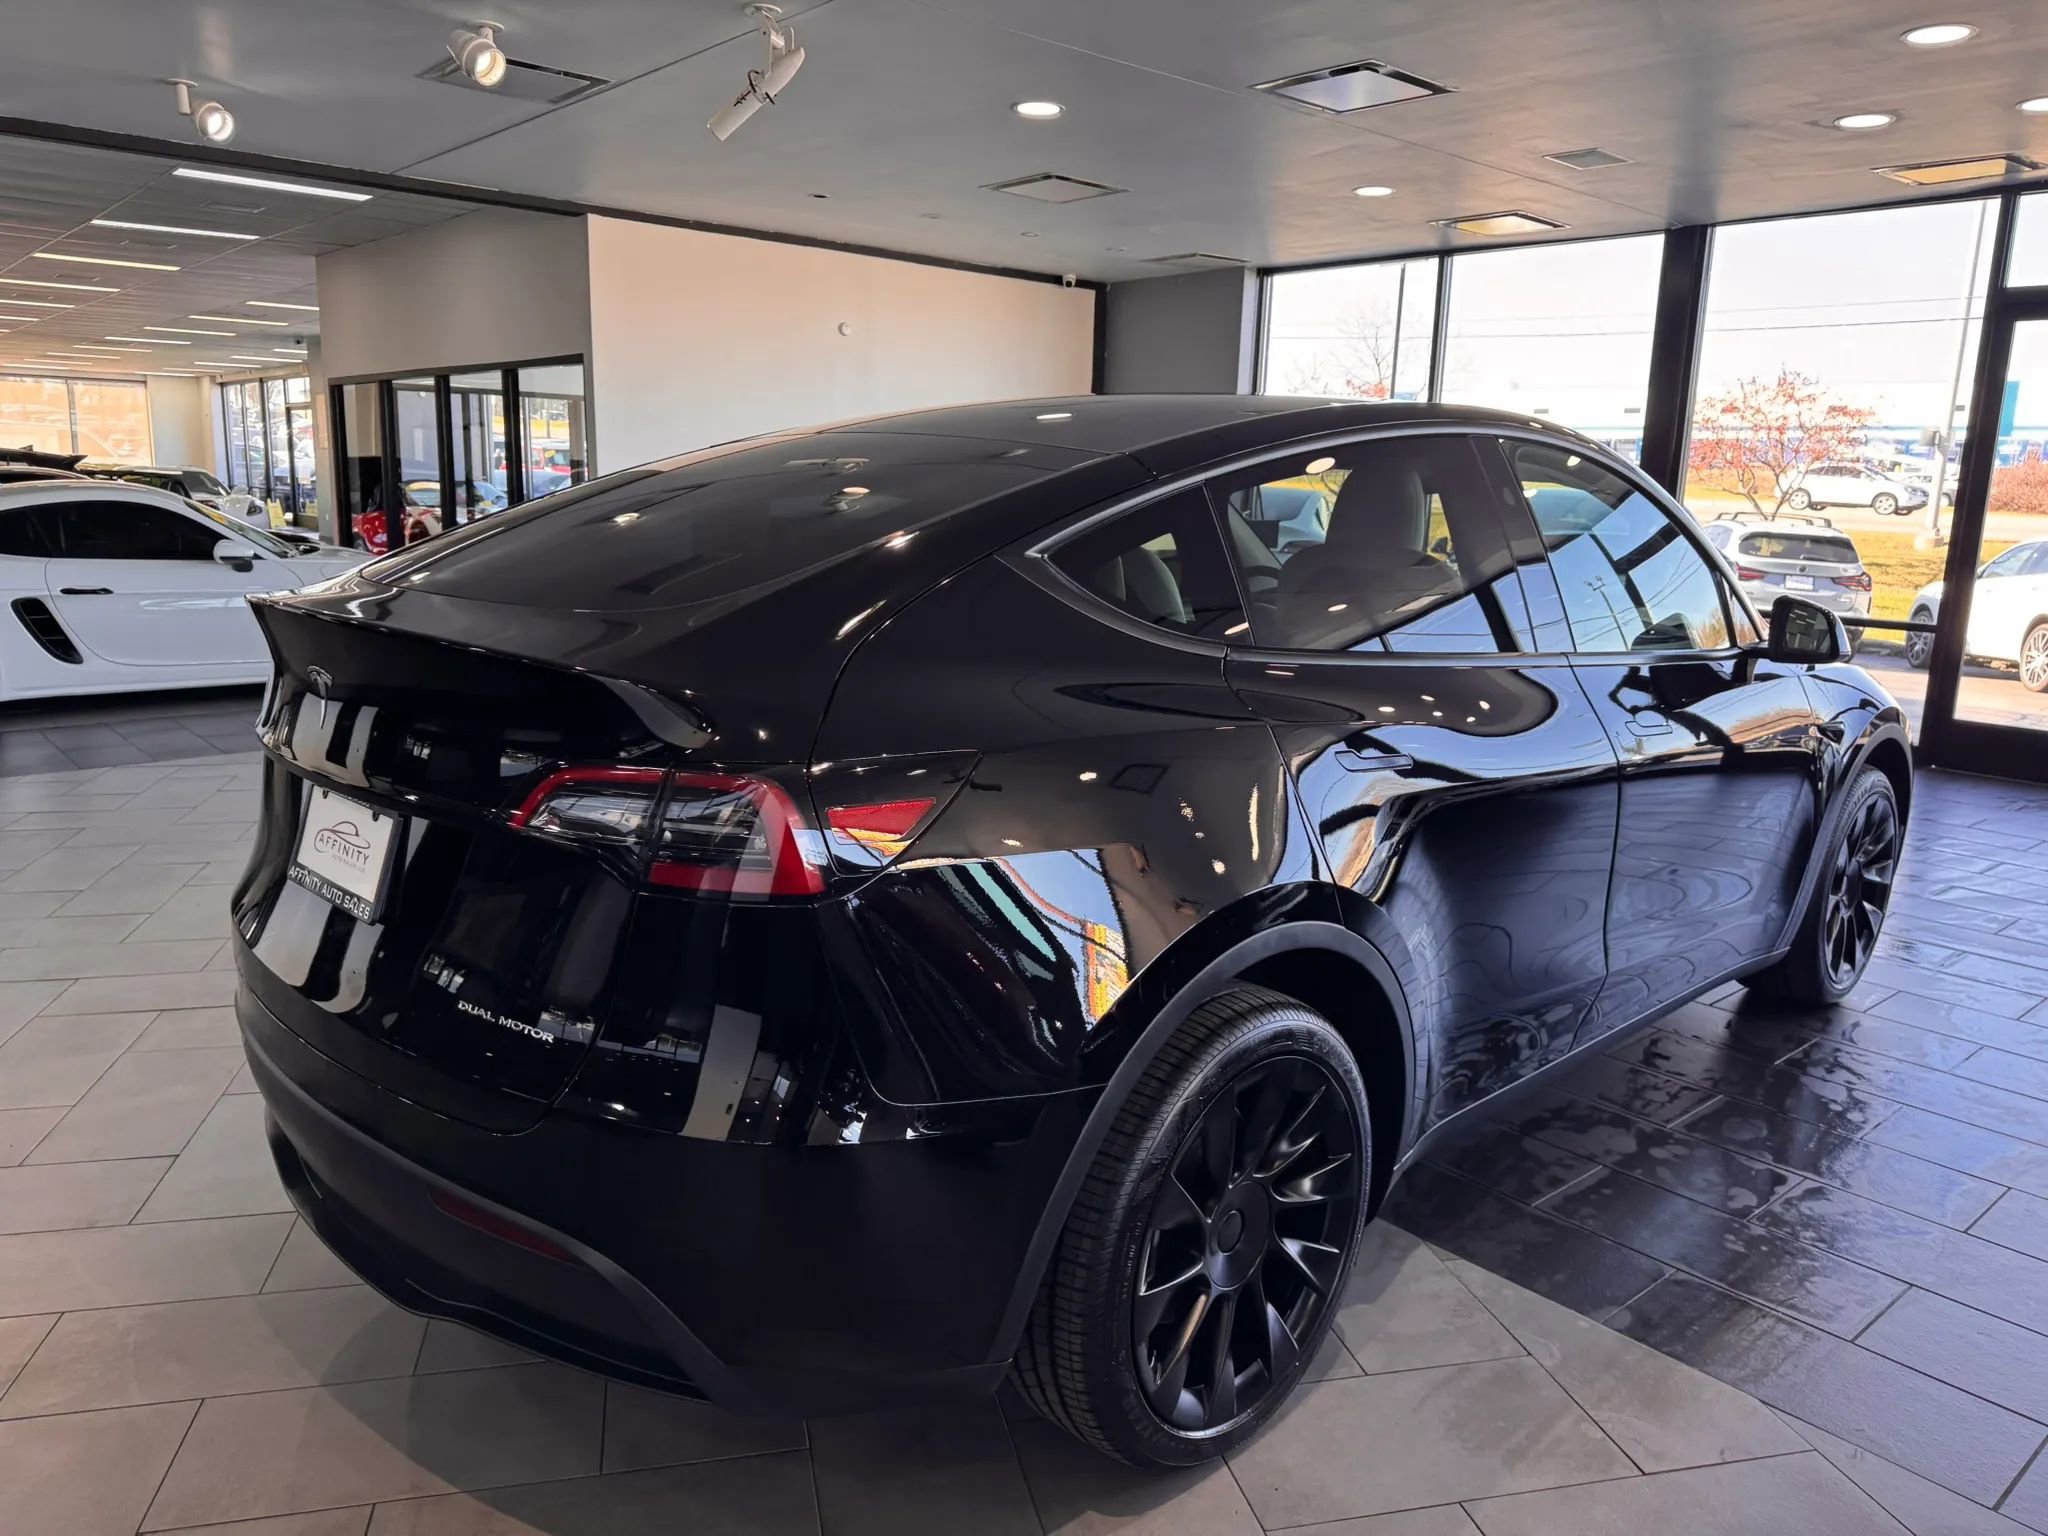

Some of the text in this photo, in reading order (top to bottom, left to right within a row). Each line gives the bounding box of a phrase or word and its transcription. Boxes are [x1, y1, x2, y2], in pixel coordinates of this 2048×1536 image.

[318, 833, 370, 865] AFFINITY
[288, 865, 370, 919] AFFINITY AUTO SALES
[457, 1000, 554, 1043] DUAL MOTOR
